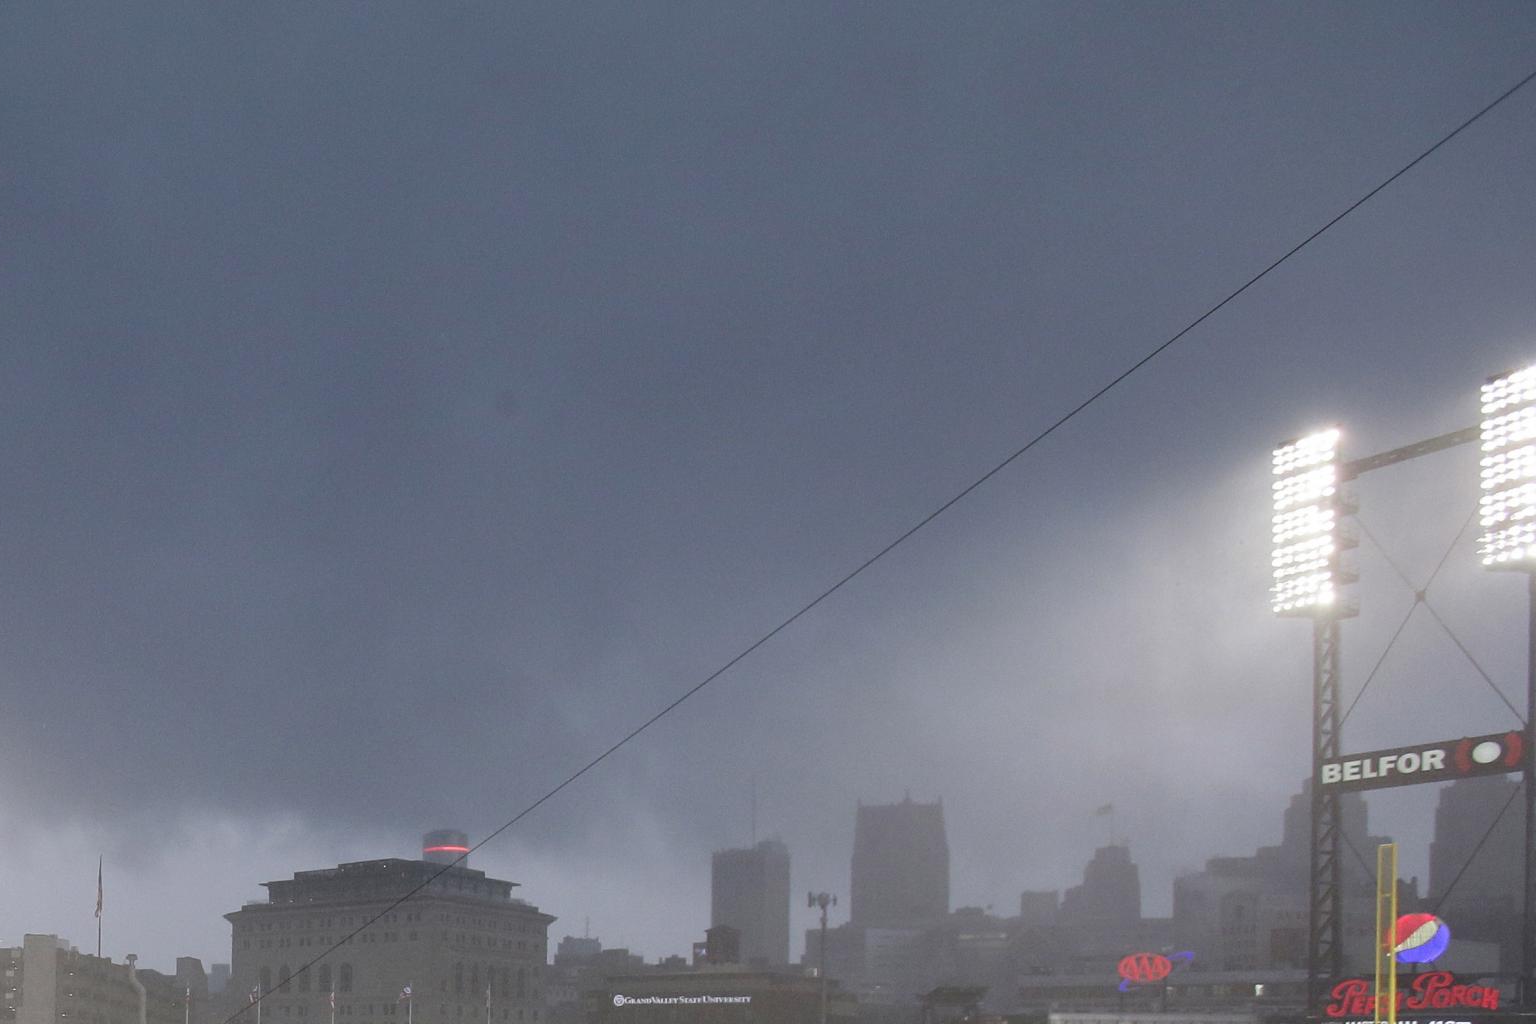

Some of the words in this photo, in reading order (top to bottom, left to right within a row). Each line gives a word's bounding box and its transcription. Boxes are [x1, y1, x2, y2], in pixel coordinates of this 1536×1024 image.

[1321, 748, 1447, 785] BELFOR
[1120, 954, 1169, 982] AAA
[678, 996, 702, 1004] STATE
[702, 995, 752, 1004] UNIVERSITY
